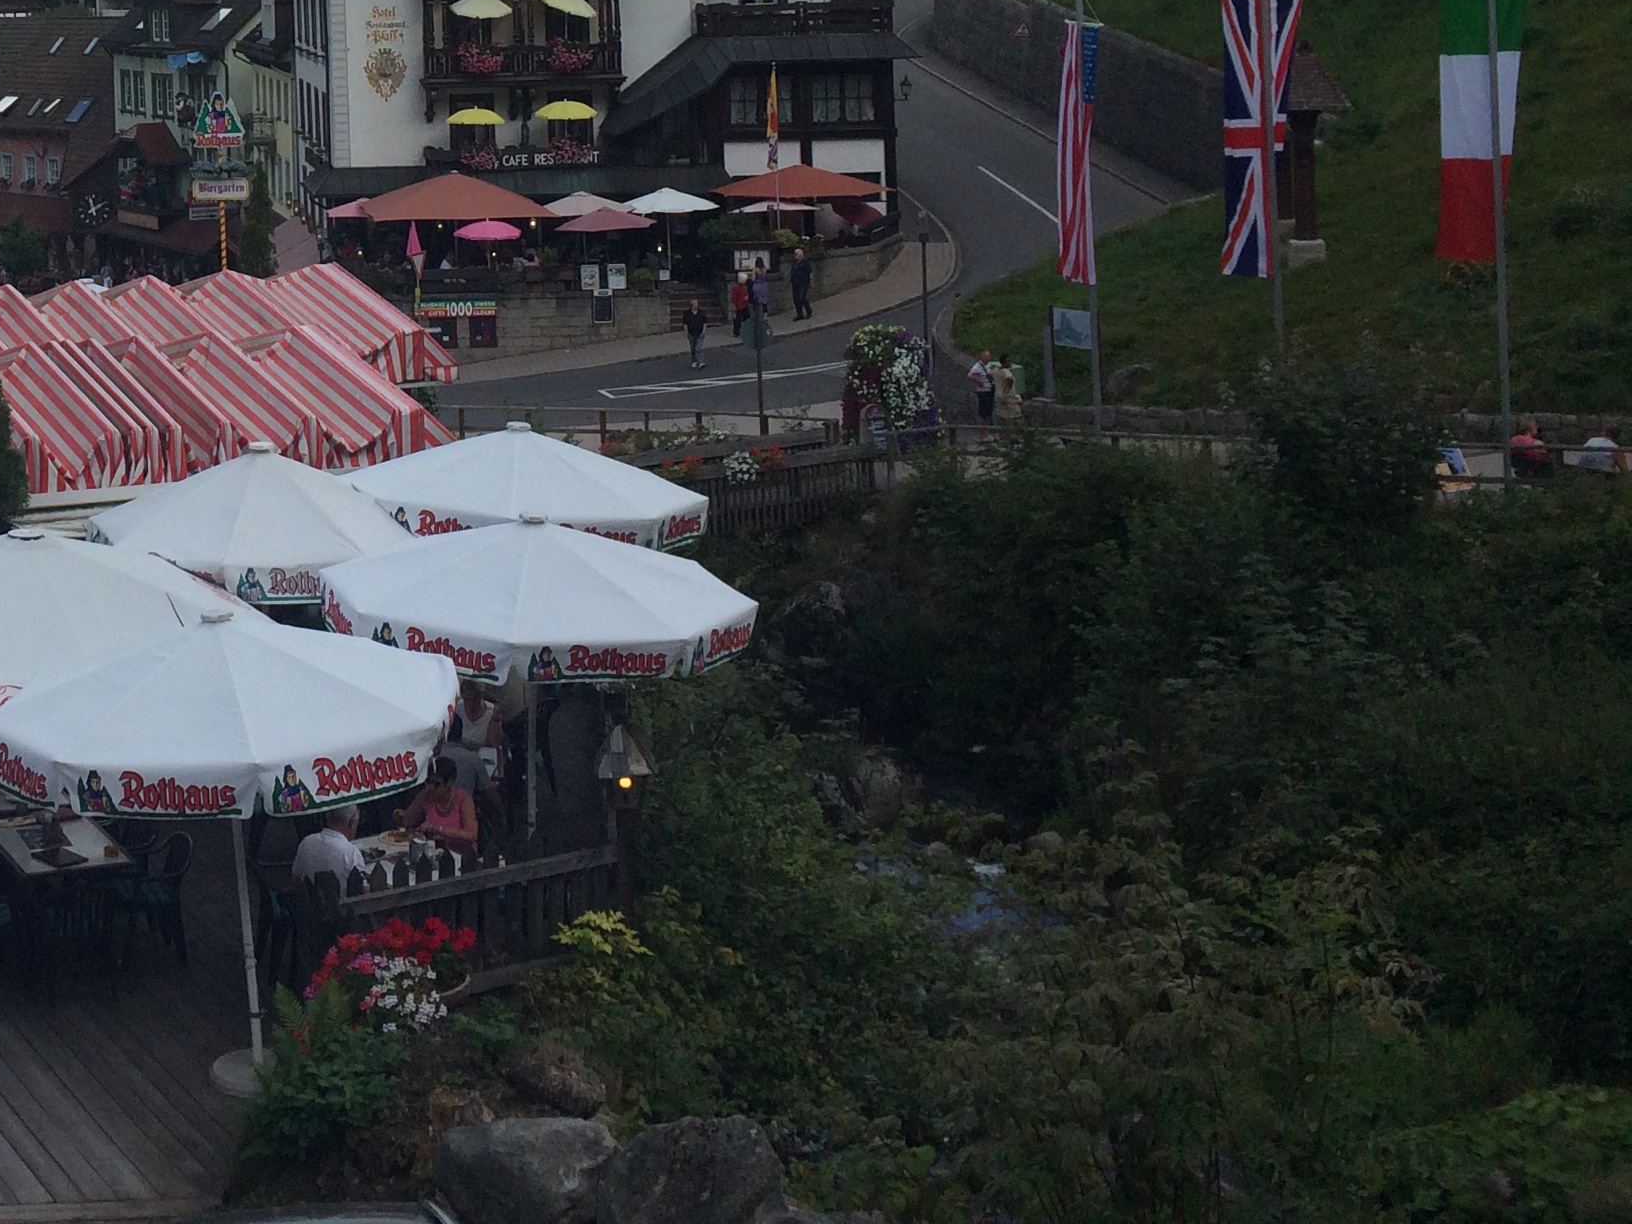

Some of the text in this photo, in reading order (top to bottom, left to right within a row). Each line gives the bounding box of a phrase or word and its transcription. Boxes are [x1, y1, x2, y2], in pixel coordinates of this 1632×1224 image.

[371, 6, 396, 18] Hotel
[196, 132, 241, 147] Rothaus
[502, 154, 528, 167] CAFE
[198, 182, 244, 194] Biergarten
[446, 301, 473, 316] 1000
[268, 567, 321, 598] Roth
[705, 622, 751, 659] Rothaus
[565, 644, 668, 676] Rothaus
[312, 750, 418, 797] Rothaus
[118, 770, 236, 815] Rothaus
